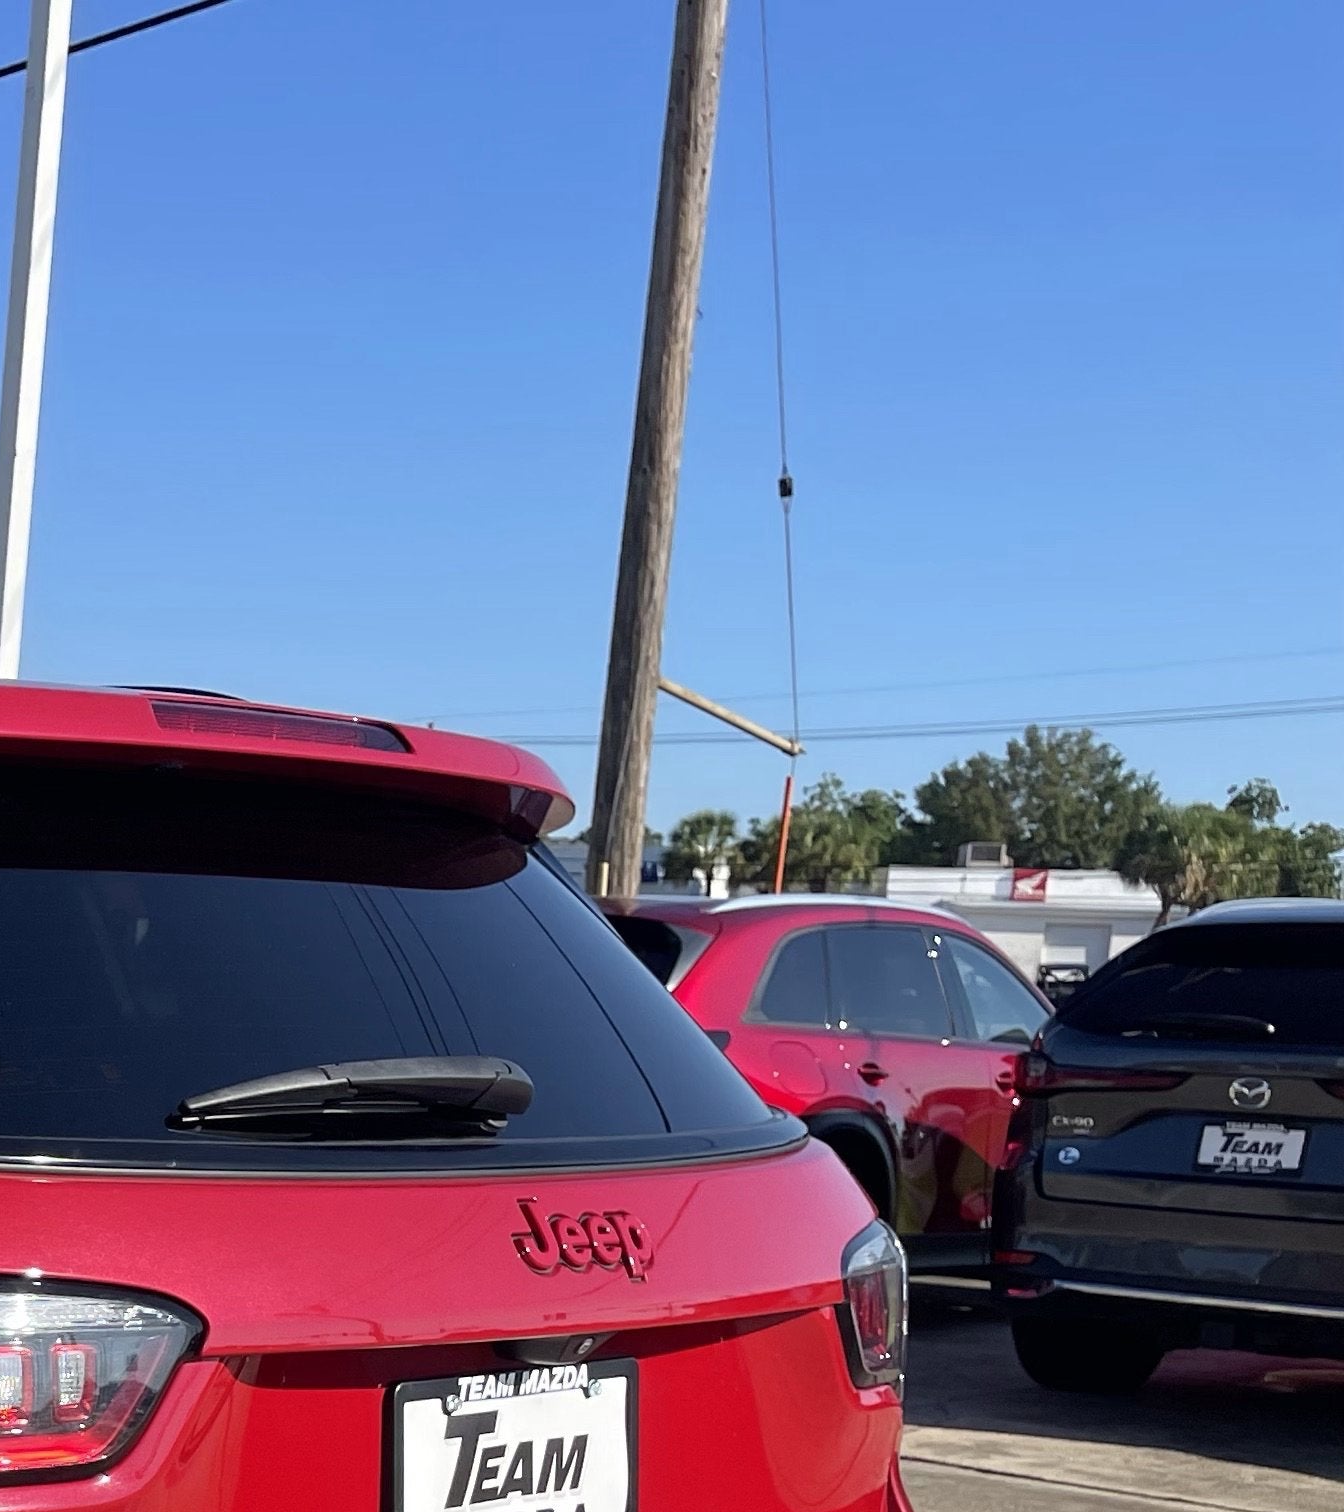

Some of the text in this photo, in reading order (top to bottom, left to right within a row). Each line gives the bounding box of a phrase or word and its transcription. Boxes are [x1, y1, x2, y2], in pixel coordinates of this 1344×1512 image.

[1219, 1133, 1286, 1156] TEAM
[511, 1197, 655, 1284] Jeep
[458, 1363, 590, 1401] TEAM MAZDA
[444, 1409, 590, 1510] TEAM
